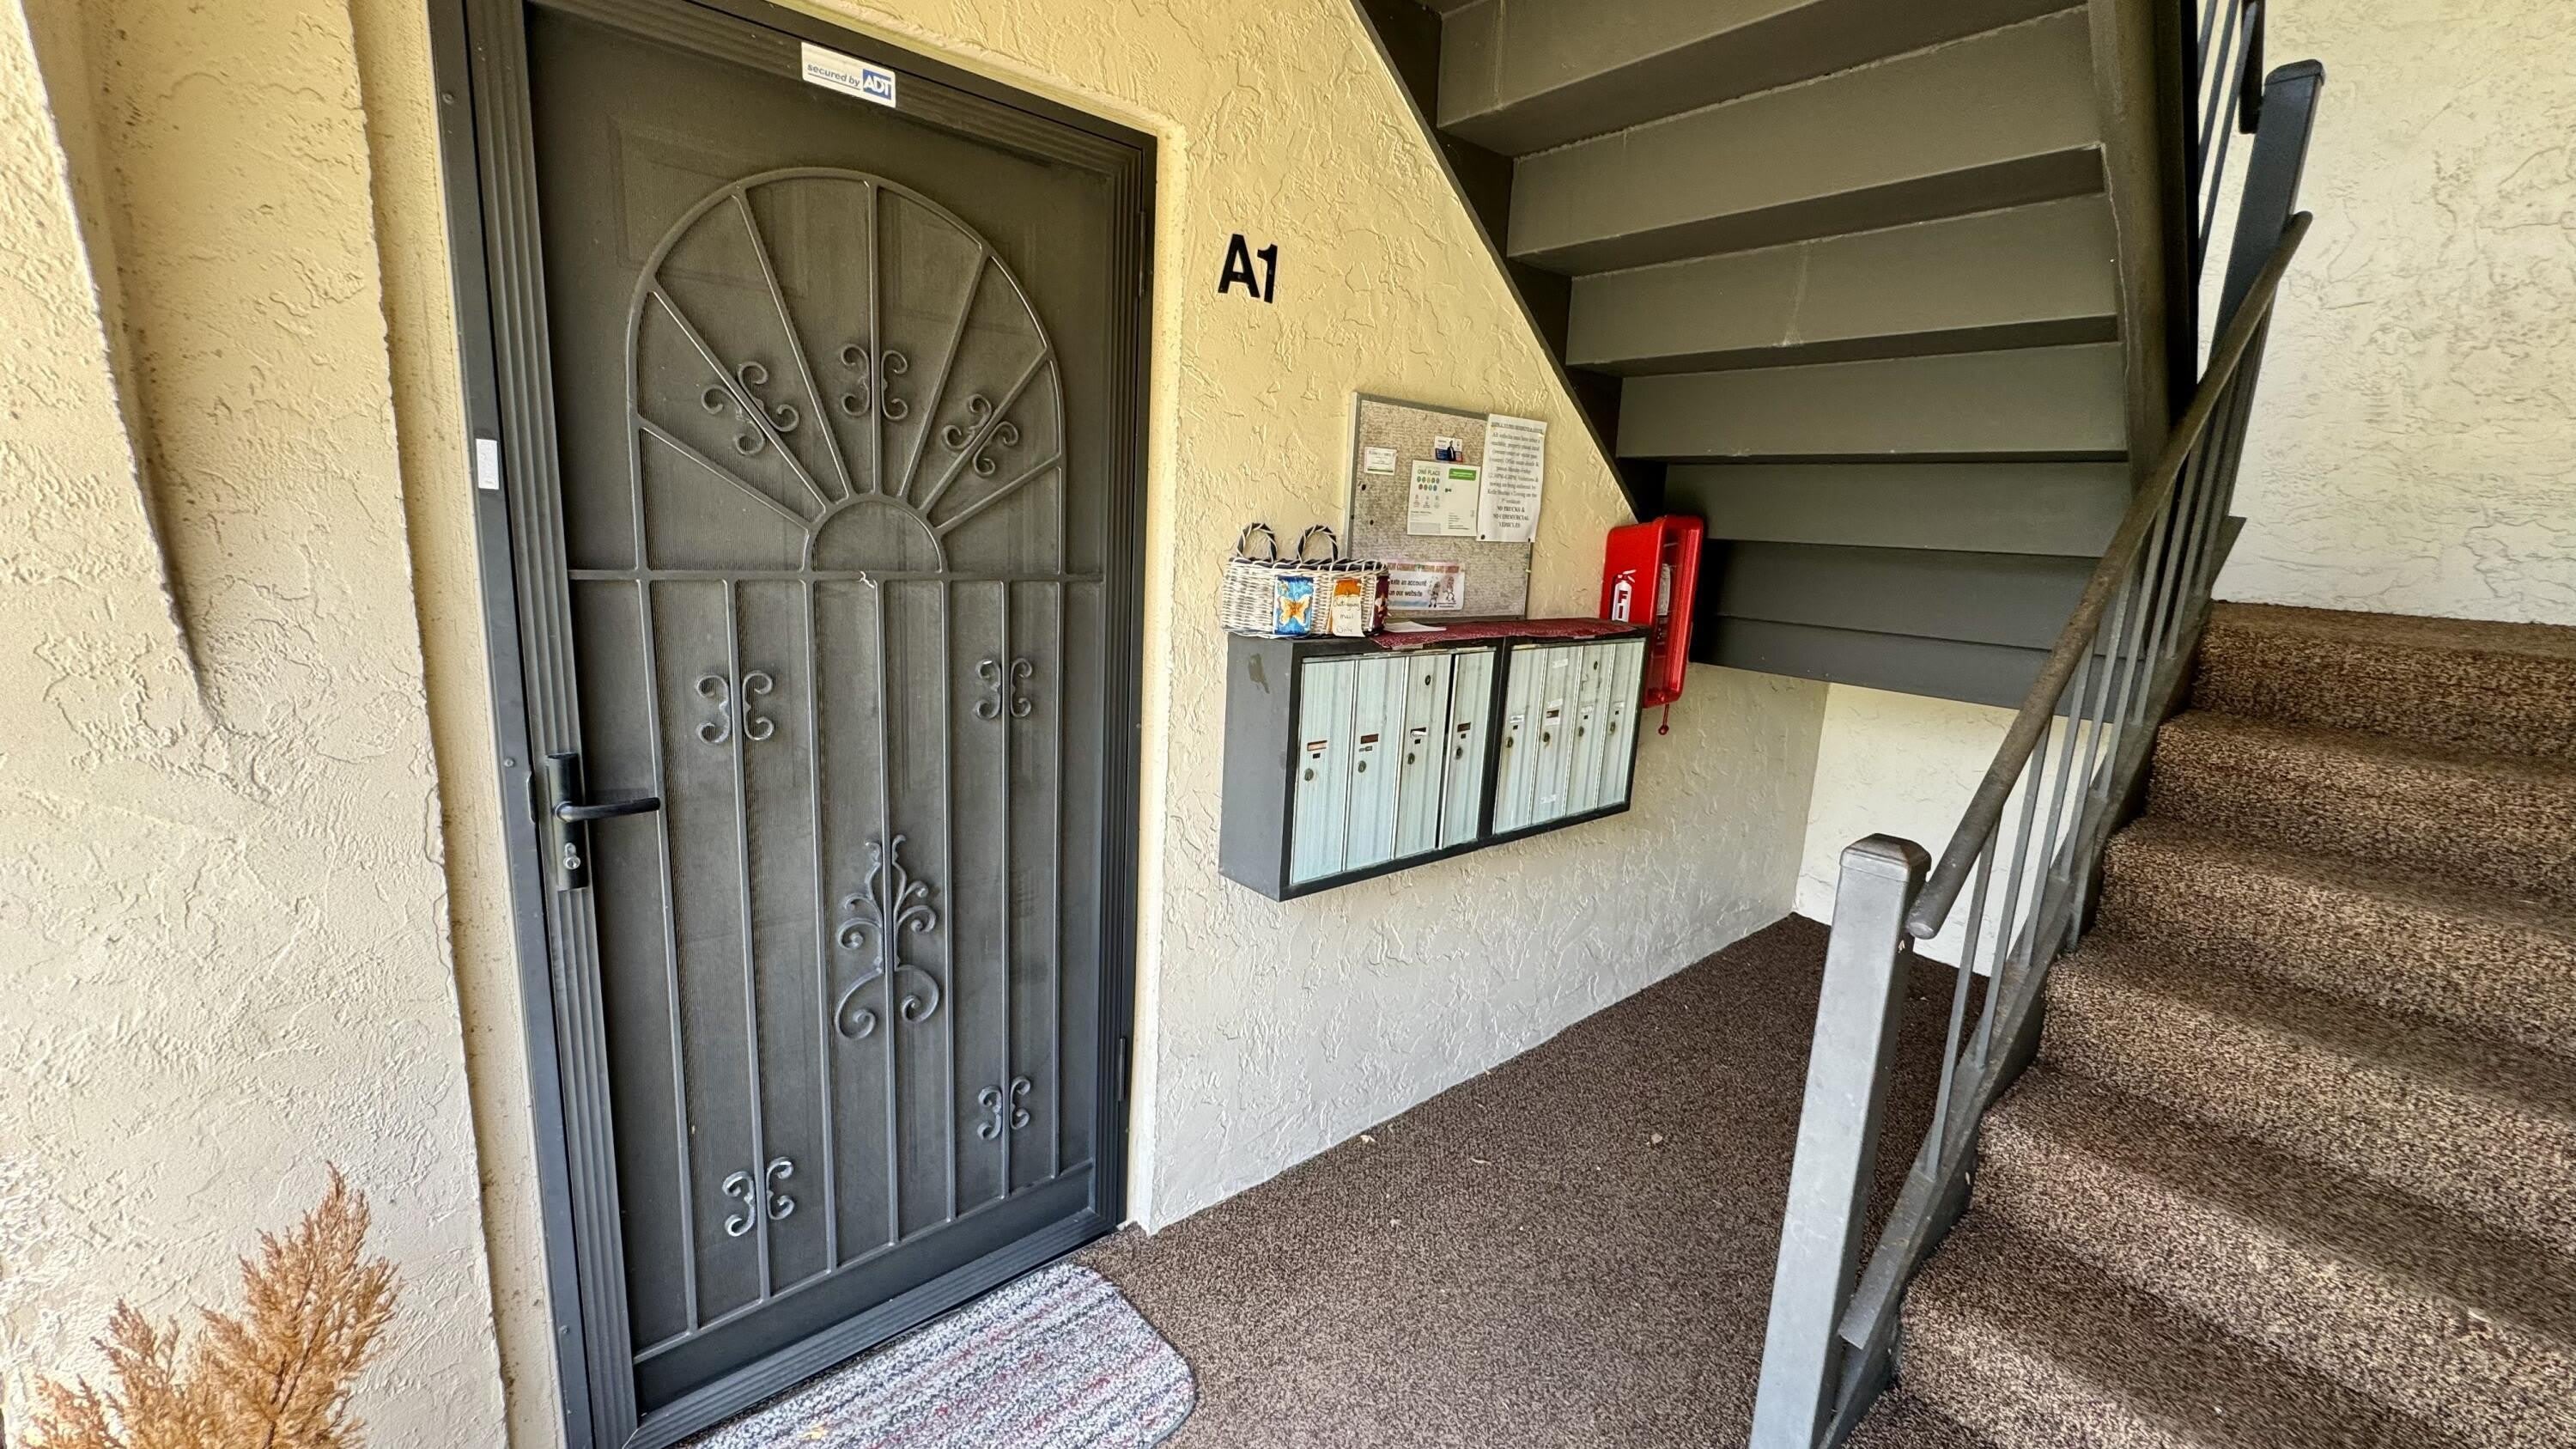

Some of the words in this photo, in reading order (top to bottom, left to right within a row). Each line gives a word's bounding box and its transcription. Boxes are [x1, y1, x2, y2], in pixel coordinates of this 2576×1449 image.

[807, 63, 848, 82] secured
[848, 76, 860, 87] by
[863, 74, 892, 96] ADT
[1218, 233, 1279, 305] A1
